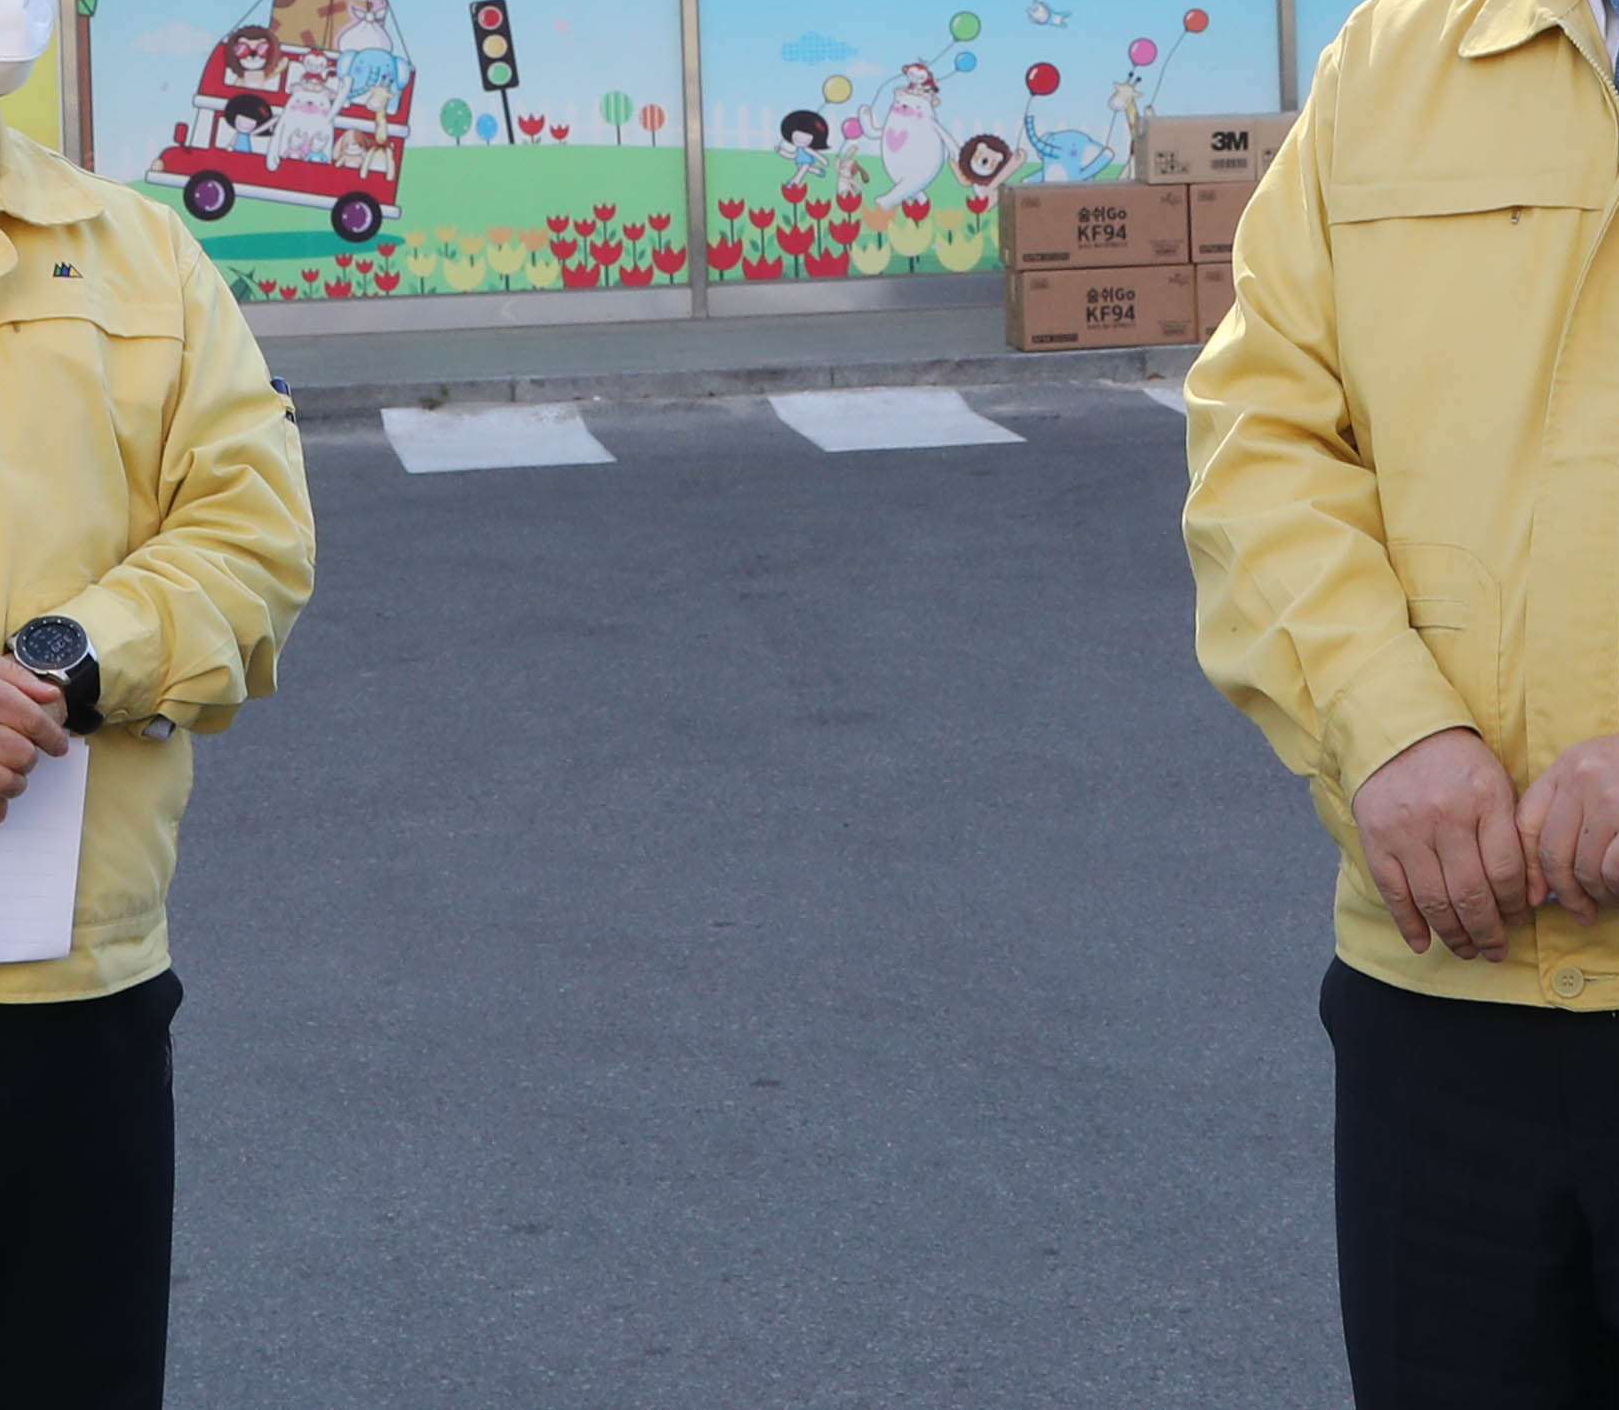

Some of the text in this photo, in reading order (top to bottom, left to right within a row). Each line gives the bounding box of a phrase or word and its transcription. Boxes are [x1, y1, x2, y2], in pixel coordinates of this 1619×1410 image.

[1210, 131, 1249, 151] 3M
[1078, 224, 1128, 242] KF94
[1086, 305, 1136, 323] KF94
